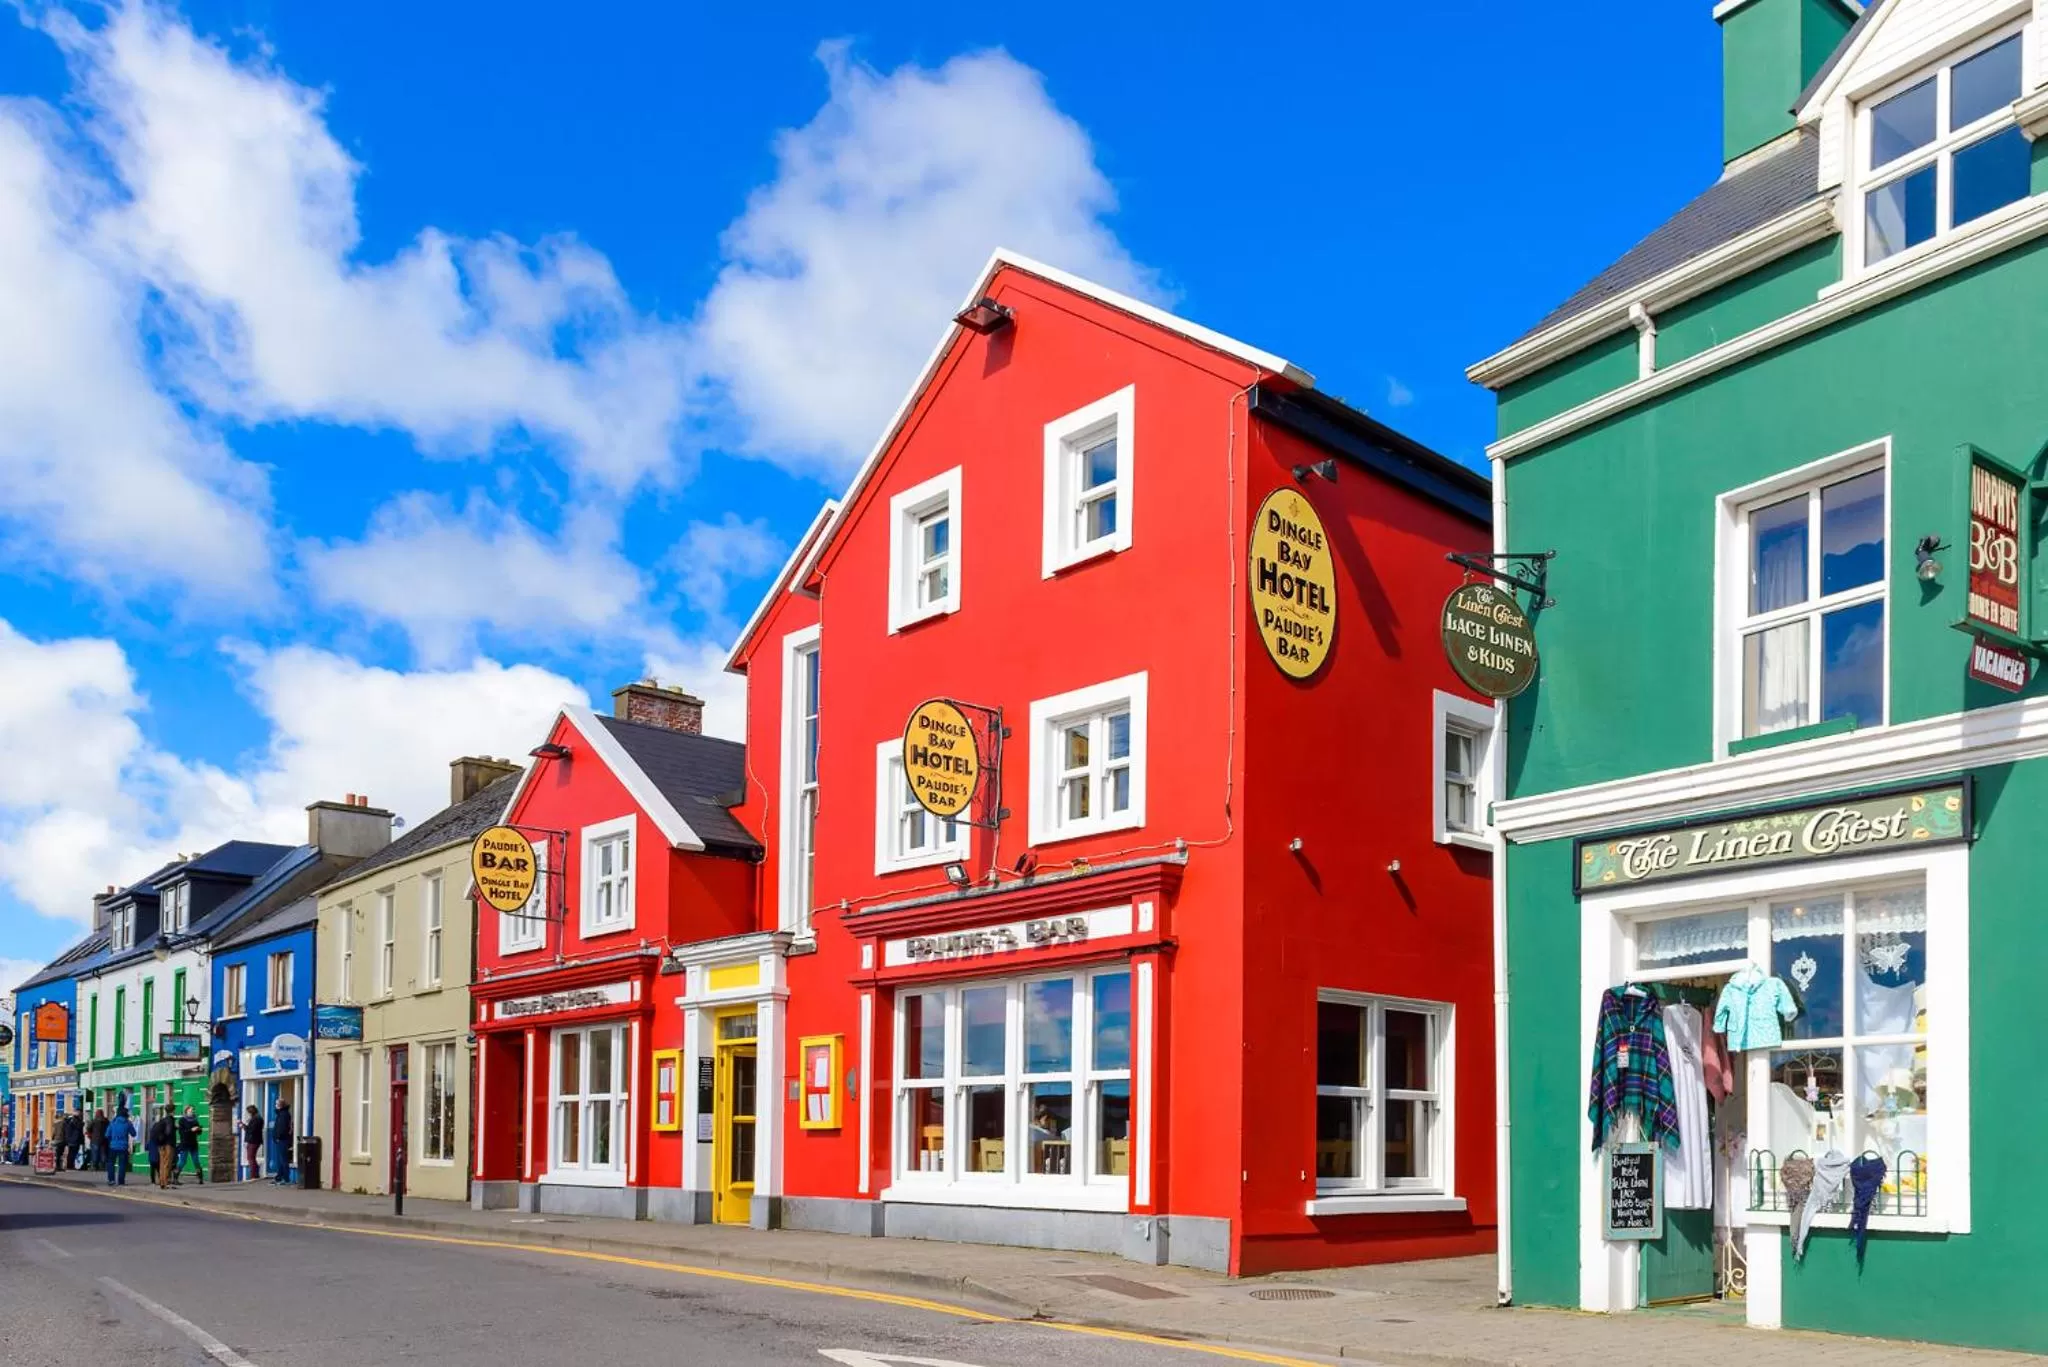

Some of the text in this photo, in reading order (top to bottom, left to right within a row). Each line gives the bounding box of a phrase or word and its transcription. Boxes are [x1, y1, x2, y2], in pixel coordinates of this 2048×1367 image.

[1268, 509, 1322, 550] DINGLE
[1278, 540, 1311, 572] BAY
[1970, 520, 2017, 585] B&B
[1257, 557, 1330, 614] HOTEL
[1475, 586, 1494, 604] The
[1457, 593, 1525, 628] Linen Chest
[1264, 608, 1323, 646] PAUDIE'S
[1446, 612, 1533, 657] LACE LINEN
[1277, 637, 1310, 663] BAR
[1480, 648, 1515, 674] KIDS
[1973, 644, 2025, 686] VACANCIES
[919, 715, 966, 737] DINGLE
[928, 733, 955, 750] BAY
[911, 744, 973, 776] HOTEL
[917, 776, 968, 796] PAUDIE'S
[929, 792, 956, 807] BAR
[483, 839, 526, 853] PAUDIE'S
[1615, 805, 1911, 880] The Linen Chest
[479, 852, 529, 872] BAR
[481, 877, 529, 889] DINGLE BAY
[489, 888, 522, 901] HOTEL
[906, 917, 1089, 958] PAUDIE'S BAR
